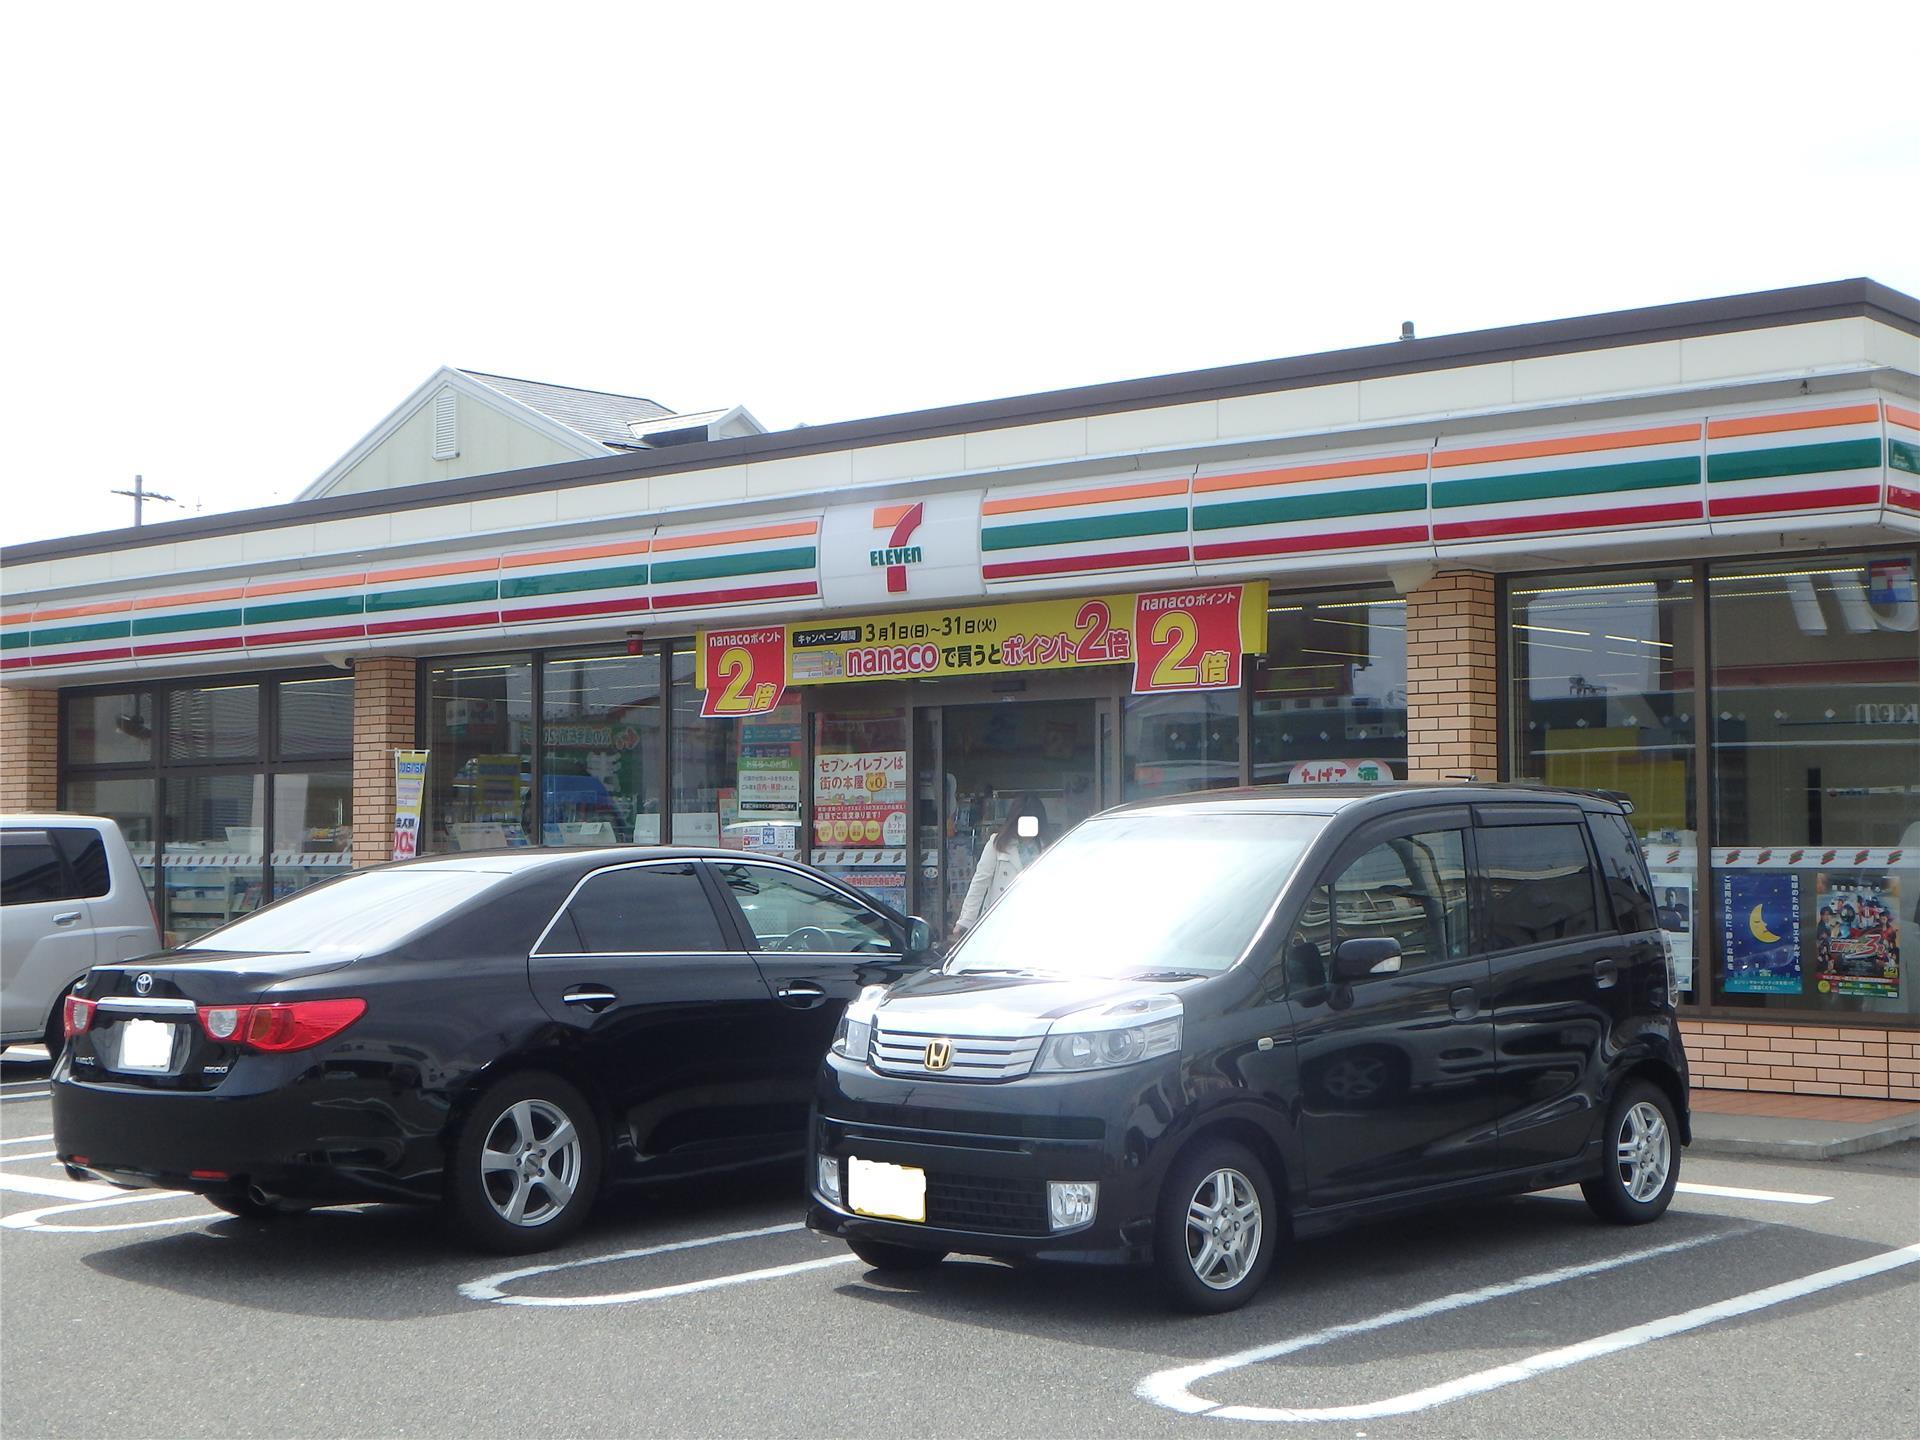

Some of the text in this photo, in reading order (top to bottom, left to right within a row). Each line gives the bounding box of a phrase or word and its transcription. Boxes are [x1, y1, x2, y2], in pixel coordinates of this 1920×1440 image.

[872, 502, 924, 593] 7
[798, 629, 856, 644] キャンペーン期間
[820, 756, 904, 773] セブン-イレブンは
